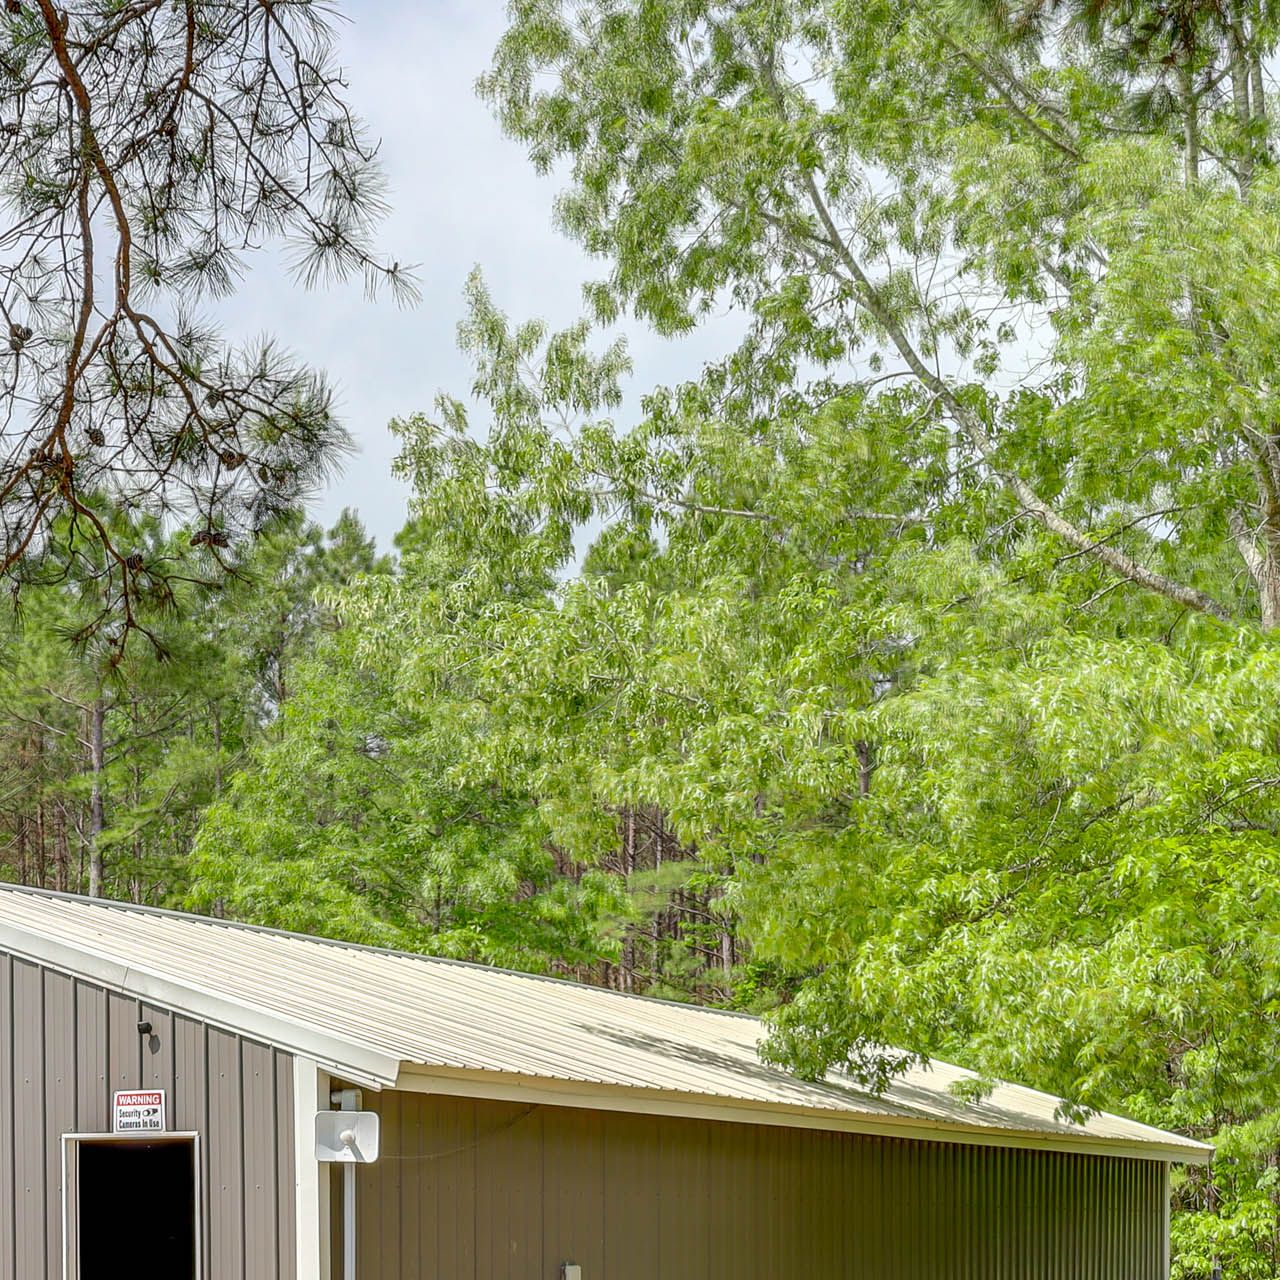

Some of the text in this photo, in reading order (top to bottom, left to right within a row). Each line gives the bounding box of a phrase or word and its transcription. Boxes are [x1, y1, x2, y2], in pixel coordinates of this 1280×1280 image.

[118, 1095, 160, 1104] WARNING
[119, 1109, 141, 1119] Security
[119, 1119, 141, 1129] Cameras
[149, 1119, 160, 1128] Use
